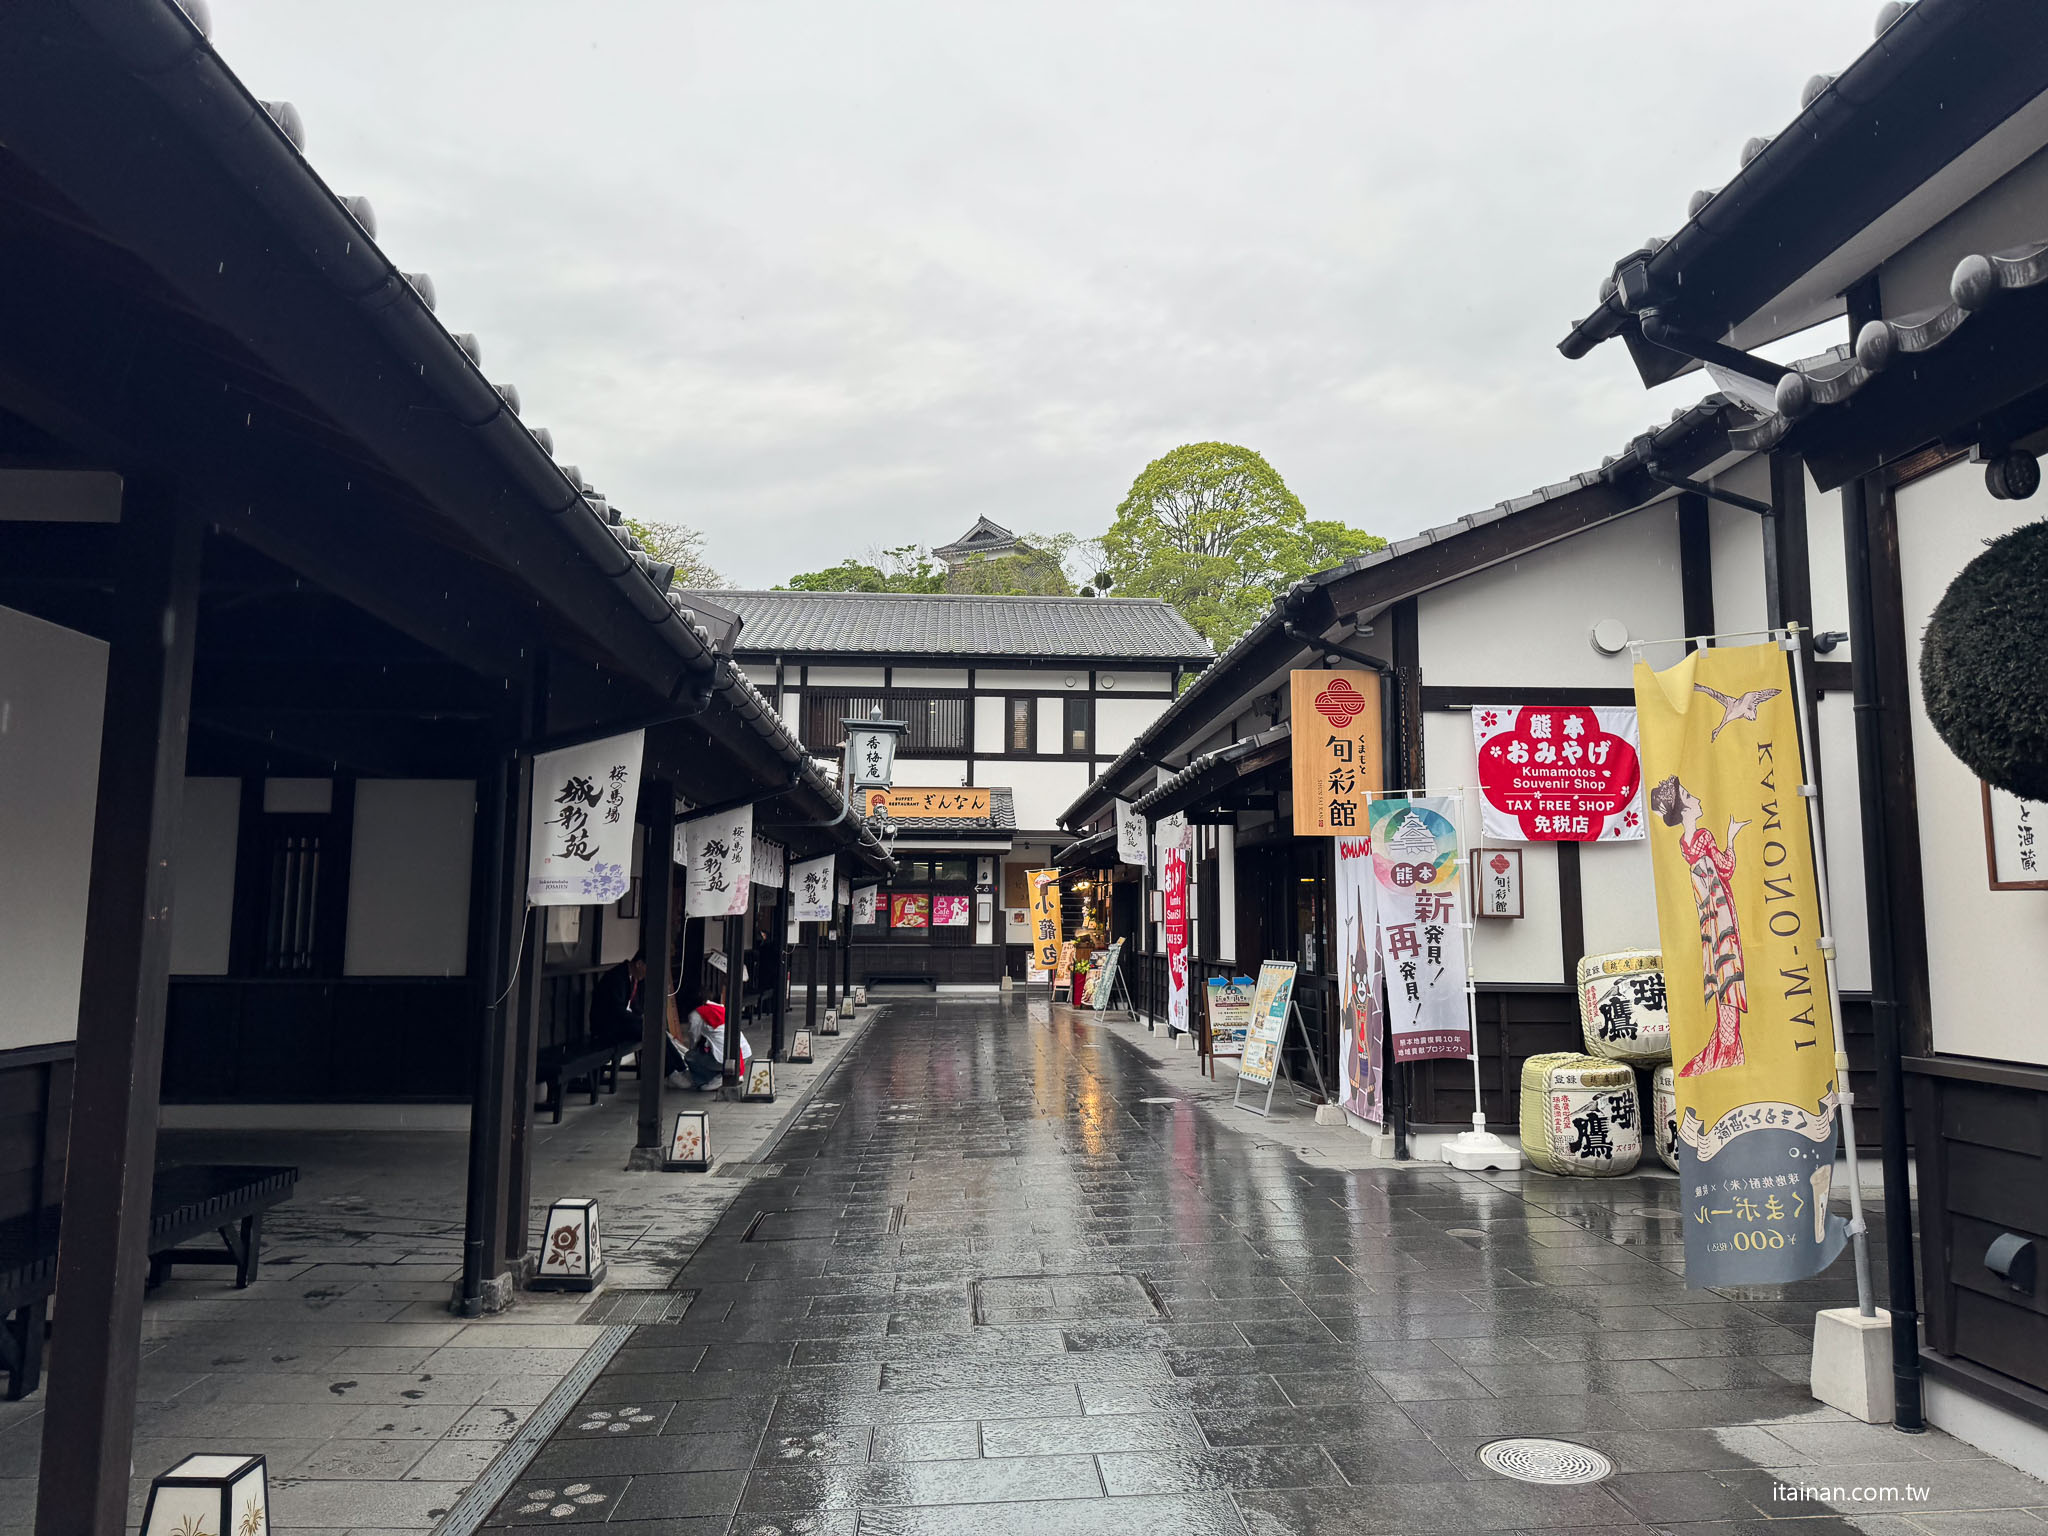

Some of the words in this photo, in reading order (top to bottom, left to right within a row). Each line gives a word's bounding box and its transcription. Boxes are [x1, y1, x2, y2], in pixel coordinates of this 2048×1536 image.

[1530, 714, 1584, 739] 熊本
[866, 735, 883, 778] 香梅庵
[1358, 734, 1366, 775] くまもと
[1507, 740, 1612, 765] おみやげ
[1325, 735, 1358, 827] 旬彩館
[1522, 766, 1596, 777] Kumamotos
[603, 765, 628, 824] 桜の馬場
[1513, 779, 1570, 789] Souvenir
[1574, 779, 1606, 791] Shop
[923, 794, 985, 810] ぎんなん
[1506, 800, 1533, 810] TAX
[1539, 800, 1571, 811] FREE
[1578, 800, 1615, 811] SHOP
[544, 776, 604, 861] 城彩苑
[1534, 815, 1589, 833] 免税店
[2017, 797, 2037, 872] と酒蔵
[695, 838, 731, 893] 城彩苑
[1395, 866, 1434, 884] 熊本
[1494, 876, 1507, 912] 旬彩館
[1398, 1045, 1466, 1056] 地域貢献プロジェクト
[1616, 1143, 1636, 1152] ズイヨウ
